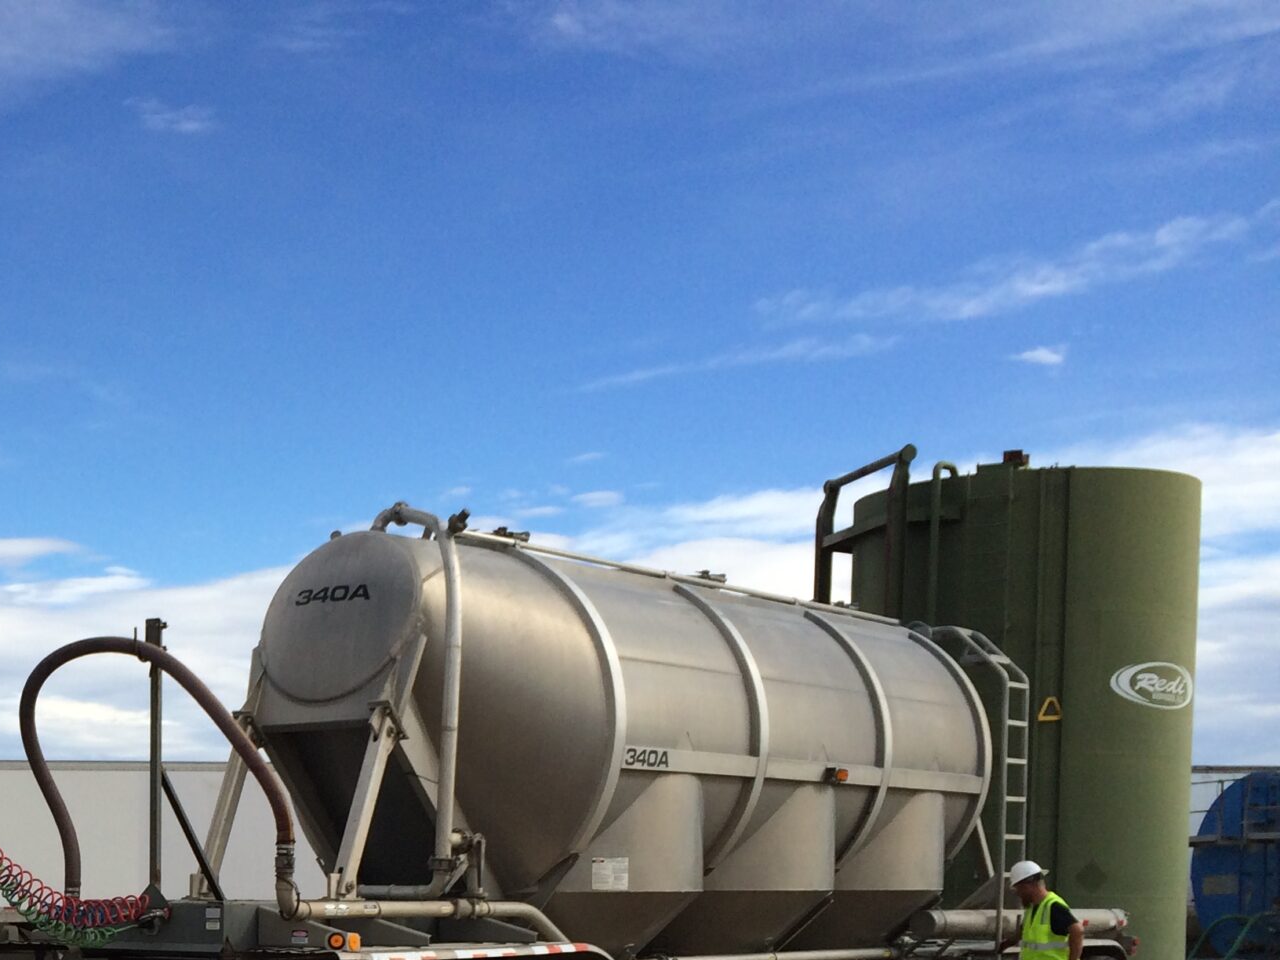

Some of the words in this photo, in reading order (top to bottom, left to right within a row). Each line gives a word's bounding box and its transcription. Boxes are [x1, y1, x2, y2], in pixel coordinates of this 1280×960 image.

[295, 584, 370, 606] 340A
[1135, 672, 1185, 694] Redi
[625, 748, 669, 768] 340A
